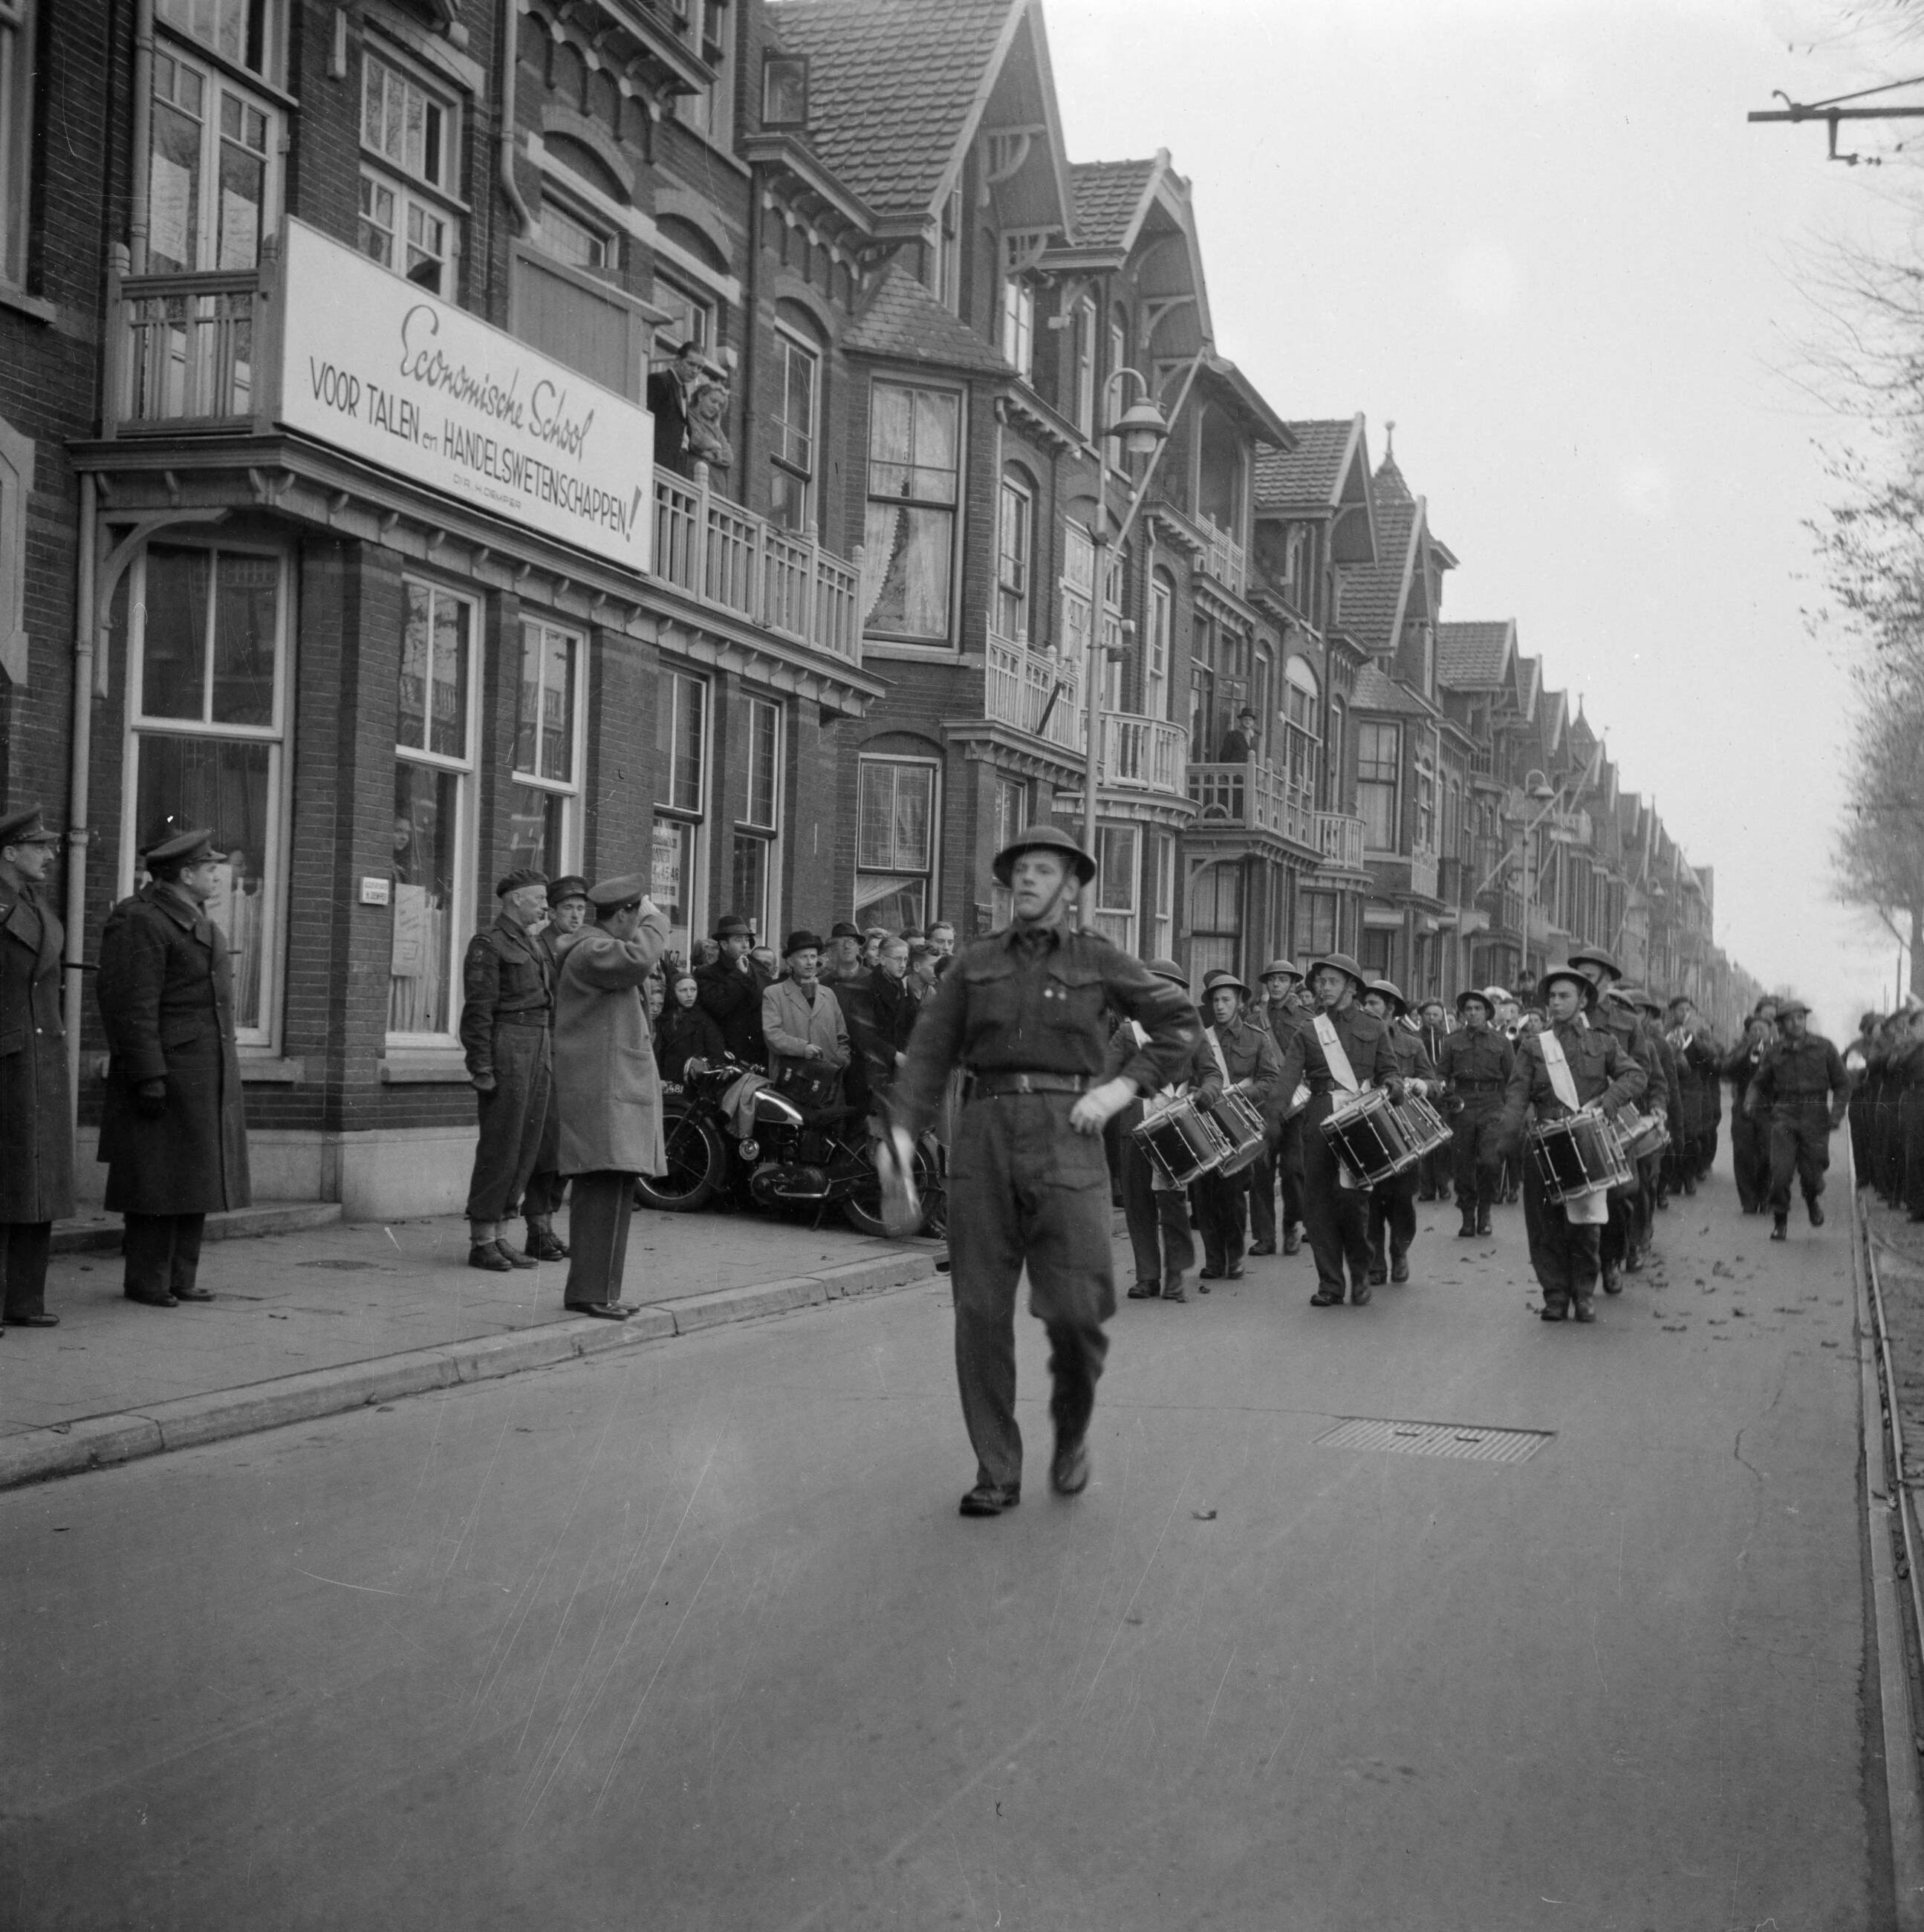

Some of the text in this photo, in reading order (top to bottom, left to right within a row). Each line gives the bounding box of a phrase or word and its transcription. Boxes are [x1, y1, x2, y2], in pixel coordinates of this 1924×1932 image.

[309, 356, 642, 543] VOOR TALEN en HANDELSWETENSCHAPPEN!
[401, 305, 594, 462] Economische School
